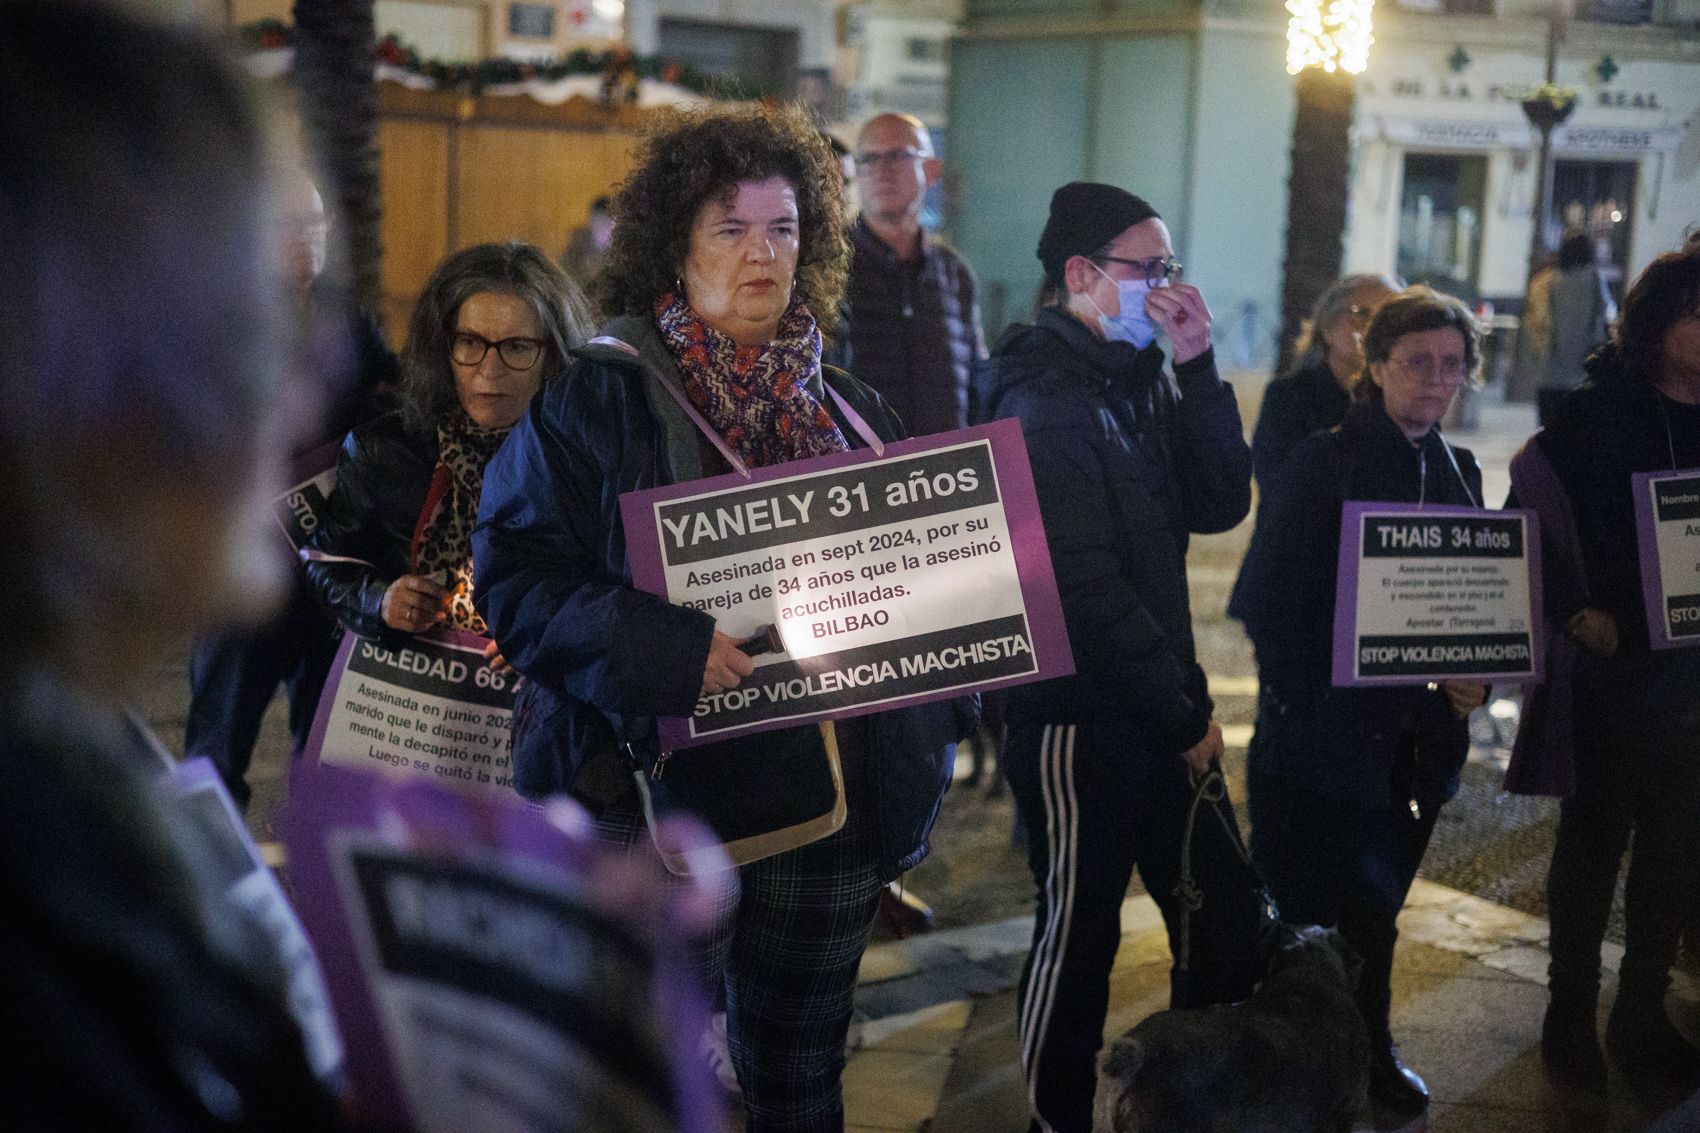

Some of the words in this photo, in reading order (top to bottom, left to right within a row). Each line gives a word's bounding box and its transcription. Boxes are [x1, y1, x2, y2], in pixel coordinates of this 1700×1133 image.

[1599, 91, 1661, 108] REAL
[287, 492, 318, 534] STO
[662, 491, 814, 548] YANELY
[828, 481, 870, 518] 31
[885, 468, 979, 507] años
[1661, 494, 1700, 506] Nombre
[686, 556, 785, 588] Asesinada
[792, 551, 816, 567] en
[821, 540, 865, 561] sept
[869, 529, 922, 552] 2024,
[926, 523, 959, 544] por
[965, 518, 989, 533] su
[1377, 525, 1442, 549] THAIS
[1451, 526, 1471, 548] 34
[1475, 528, 1511, 549] años
[681, 590, 743, 611] pareja
[748, 584, 773, 601] de
[777, 577, 801, 596] 34
[807, 569, 855, 590] años
[860, 561, 897, 581] que
[902, 555, 920, 570] la
[925, 535, 1001, 566] asesinó
[781, 585, 911, 620] acuchilladas.
[812, 609, 889, 639] BILBAO
[1360, 646, 1399, 664] STOP
[1401, 645, 1473, 663] VIOLENCIA
[1476, 643, 1529, 661] MACHISTA
[693, 687, 760, 718] STOP
[763, 660, 898, 702] VIOLENCIA
[900, 634, 1031, 678] MACHISTA
[357, 683, 418, 712] Asesinada
[422, 704, 440, 716] en
[443, 706, 481, 724] junio
[345, 700, 384, 721] marido
[387, 713, 411, 729] que
[416, 719, 427, 733] le
[432, 725, 489, 745] disparó
[493, 738, 502, 749] y
[349, 721, 385, 741] mente
[389, 731, 400, 746] la
[404, 737, 468, 762] decapitó
[473, 752, 491, 765] en
[496, 756, 509, 768] el
[369, 745, 409, 766] Luego
[413, 759, 430, 771] se
[434, 763, 472, 781] quitó
[477, 769, 490, 783] la
